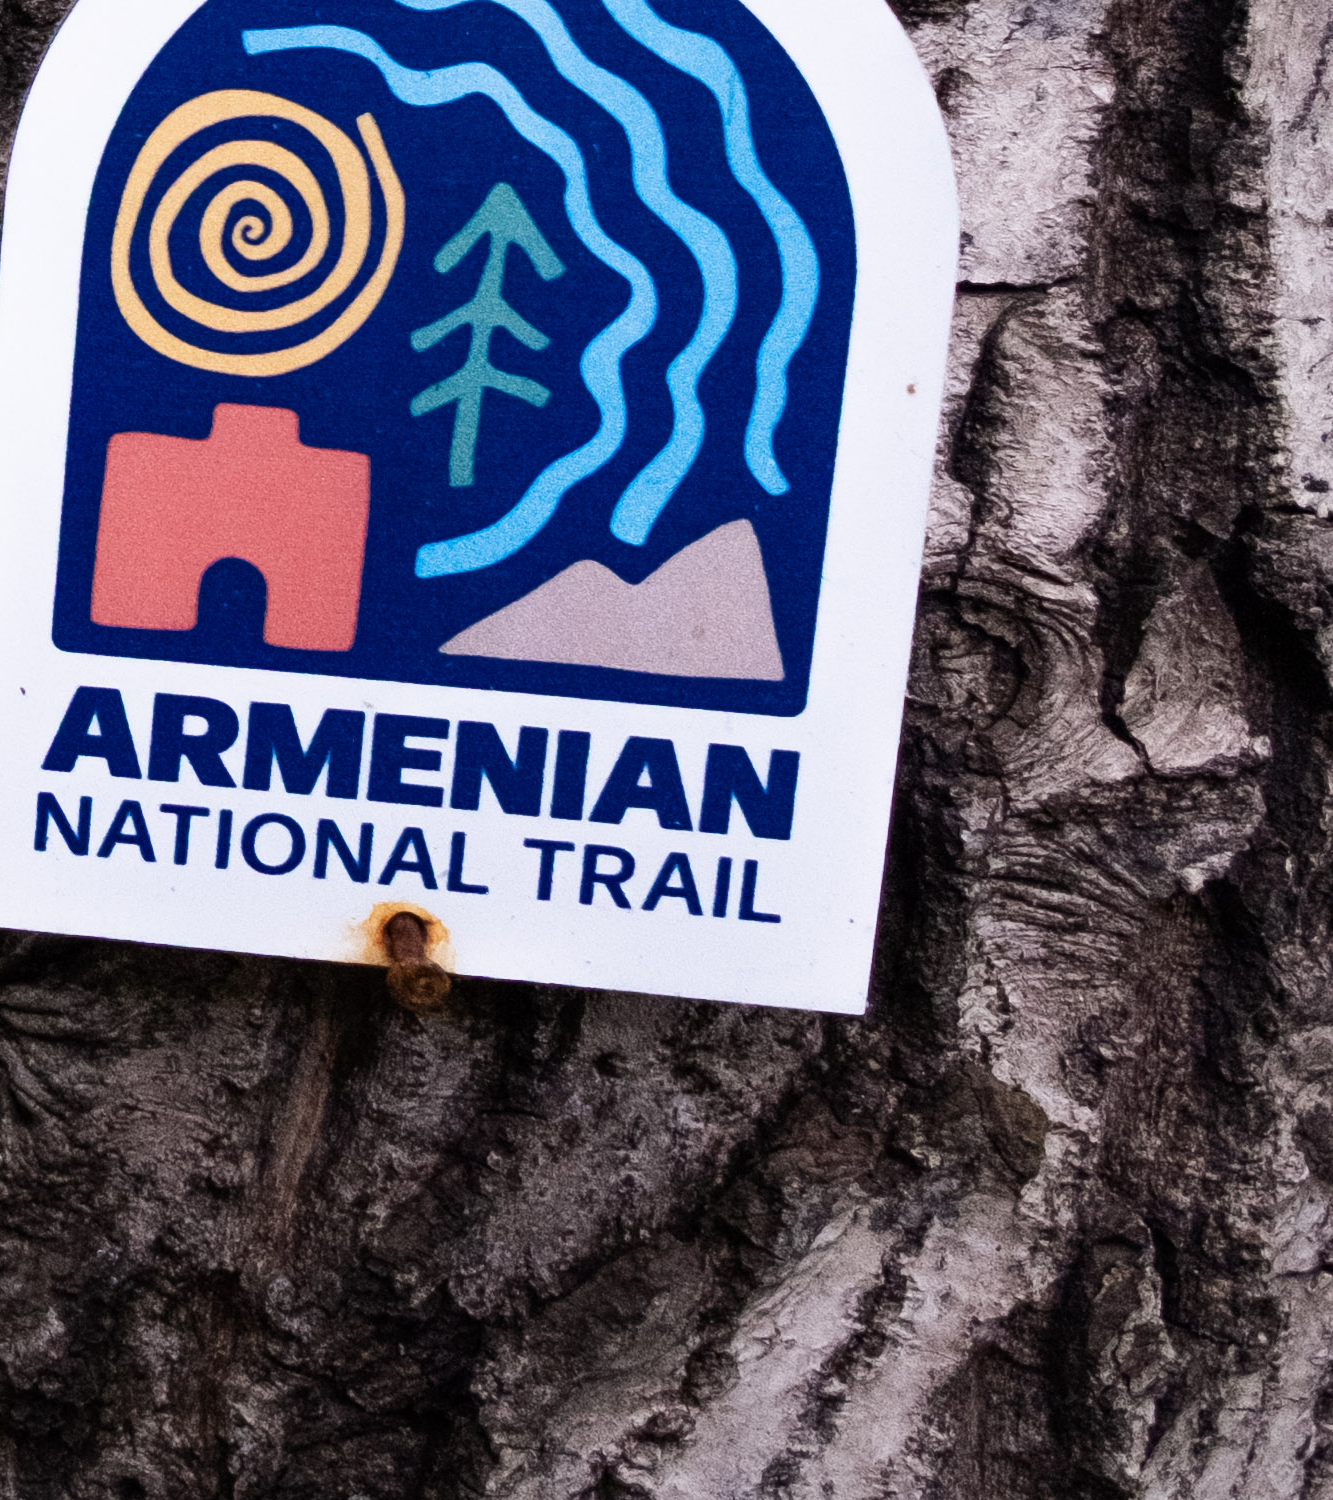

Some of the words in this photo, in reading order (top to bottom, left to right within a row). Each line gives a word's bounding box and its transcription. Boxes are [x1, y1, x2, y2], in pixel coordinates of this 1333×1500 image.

[40, 685, 801, 842] ARMENIAN
[33, 791, 490, 895] NATIONAL
[523, 838, 782, 924] TRAIL
